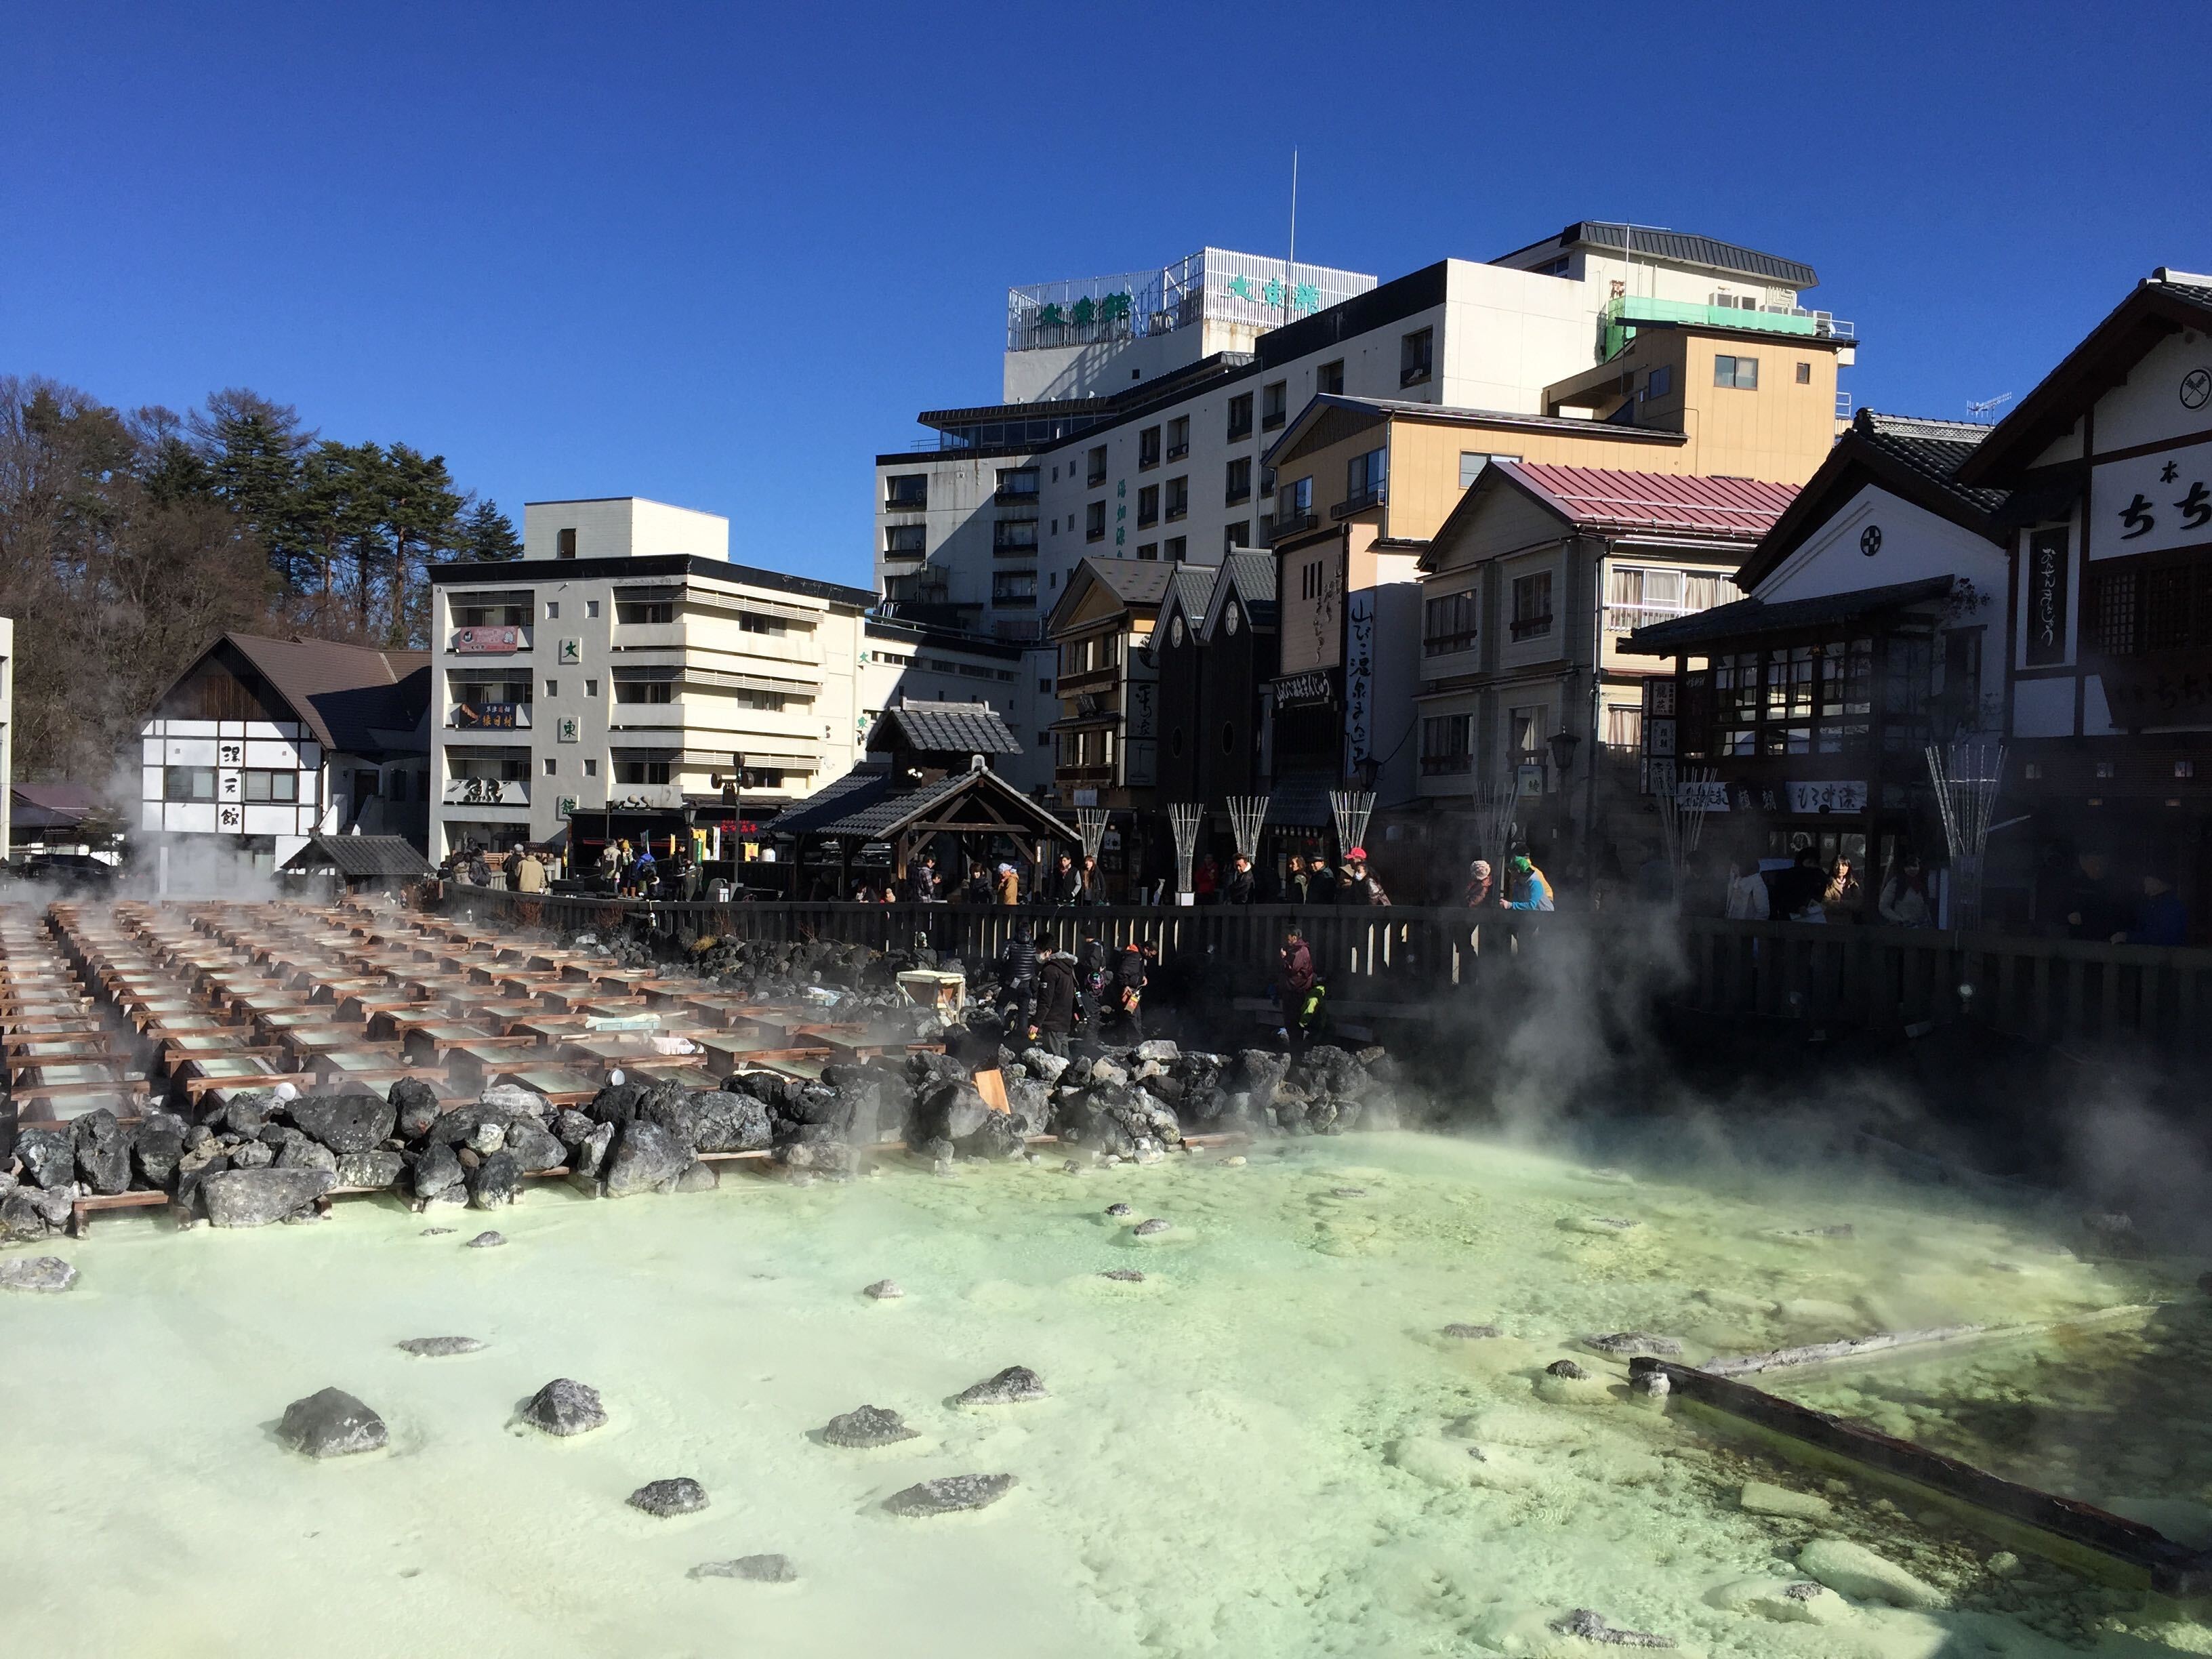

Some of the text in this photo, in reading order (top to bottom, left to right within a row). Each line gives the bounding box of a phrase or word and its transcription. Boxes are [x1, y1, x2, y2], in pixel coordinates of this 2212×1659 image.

[1221, 274, 1320, 314] 大東館
[2160, 461, 2178, 483] 本
[2118, 482, 2212, 539] ちち
[464, 777, 504, 803] 魚民
